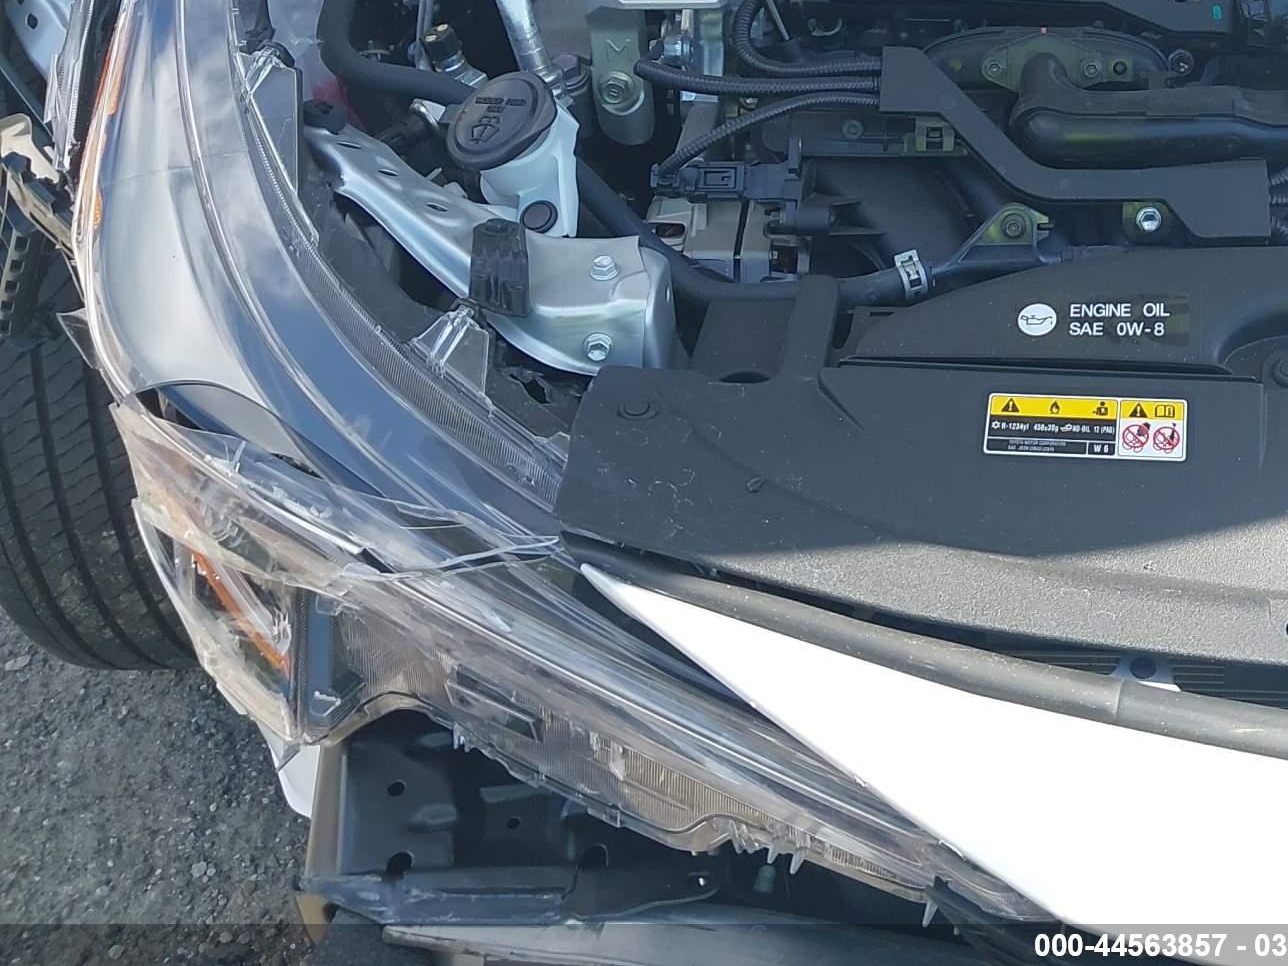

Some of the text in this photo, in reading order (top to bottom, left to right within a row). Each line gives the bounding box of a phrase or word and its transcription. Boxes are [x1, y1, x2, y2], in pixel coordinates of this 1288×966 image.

[1069, 303, 1170, 318] ENGINE OIL
[1069, 322, 1165, 336] SAE 0W-8
[1093, 444, 1109, 453] W 6
